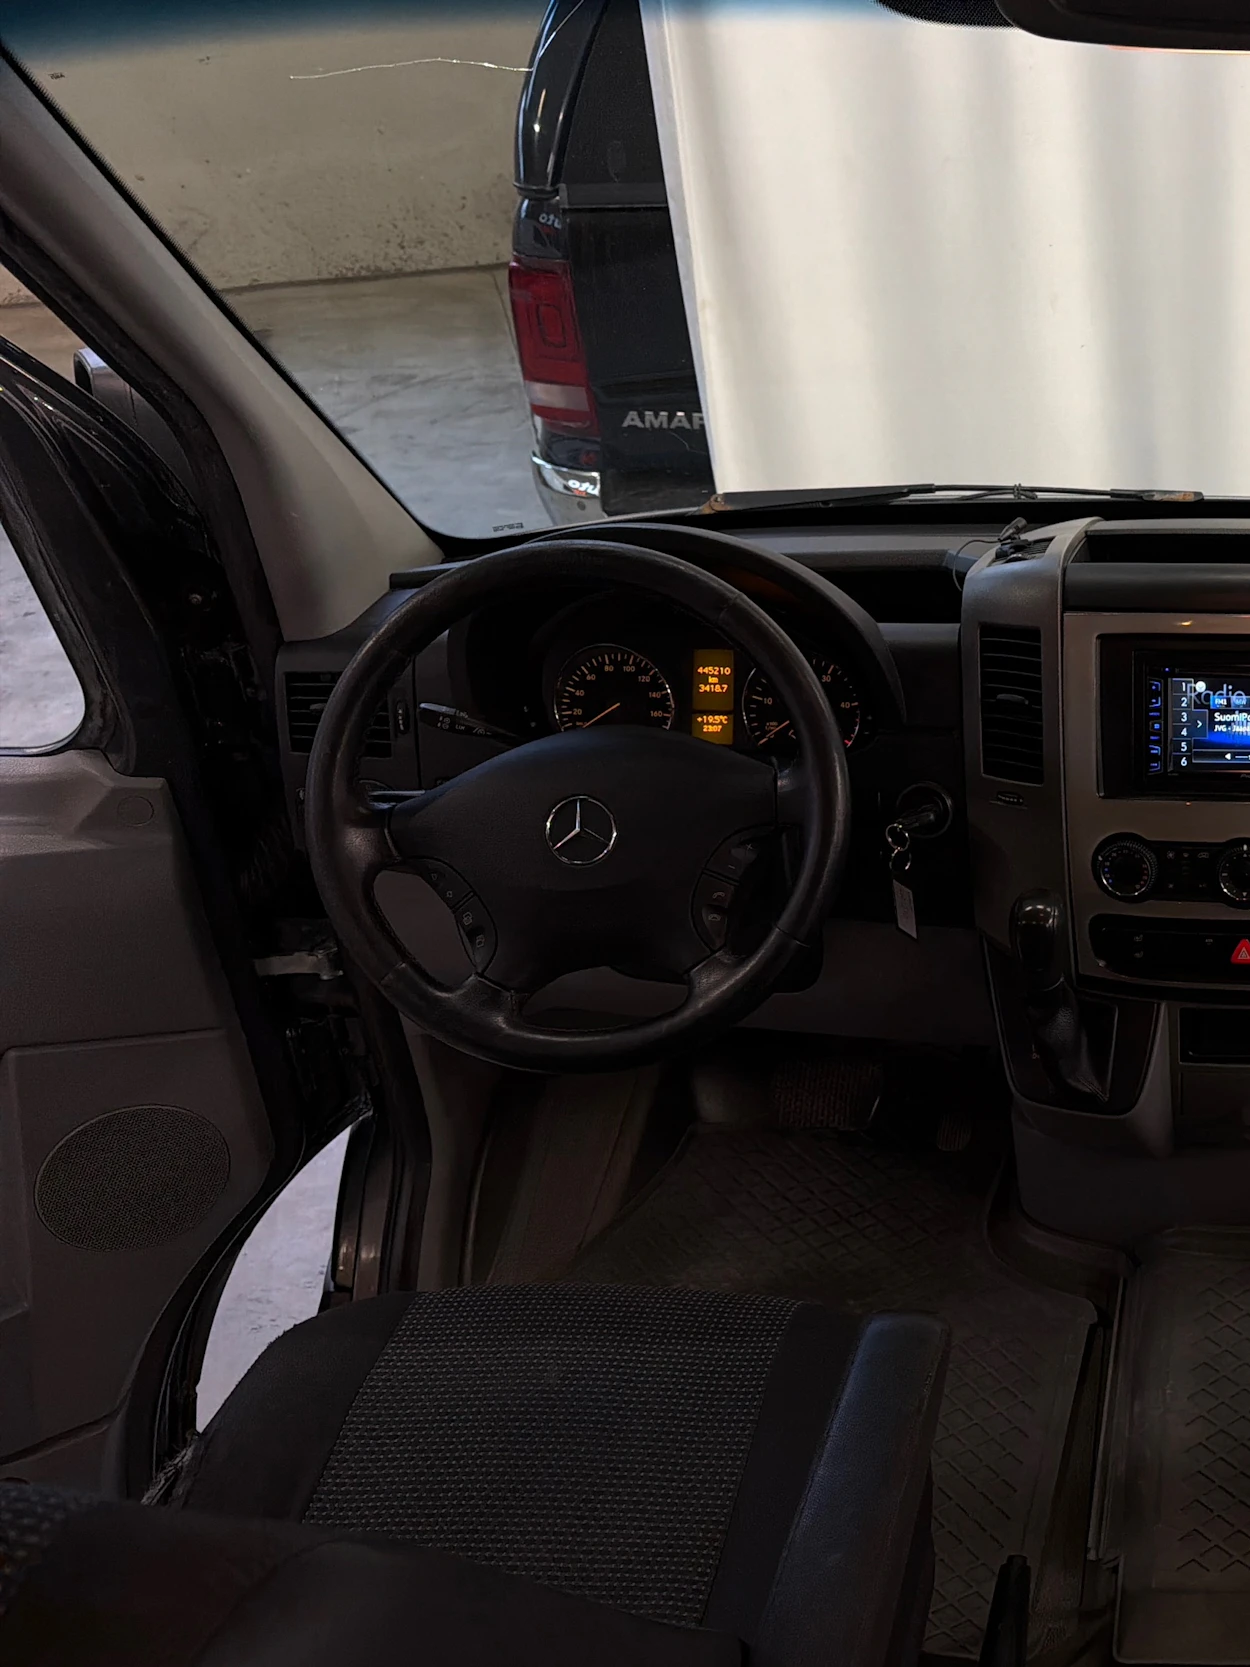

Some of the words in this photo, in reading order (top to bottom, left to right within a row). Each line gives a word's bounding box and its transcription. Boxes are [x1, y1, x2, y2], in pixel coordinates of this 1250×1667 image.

[697, 666, 731, 675] 445210
[698, 684, 728, 693] 3418.7
[1181, 682, 1186, 692] 1
[575, 689, 585, 697] 40
[763, 697, 773, 705] 10
[840, 701, 851, 709] 40
[1181, 697, 1188, 707] 2
[1181, 712, 1188, 722] 3
[1181, 727, 1188, 736] 4
[1181, 742, 1188, 751] 5
[1181, 757, 1188, 767] 6
